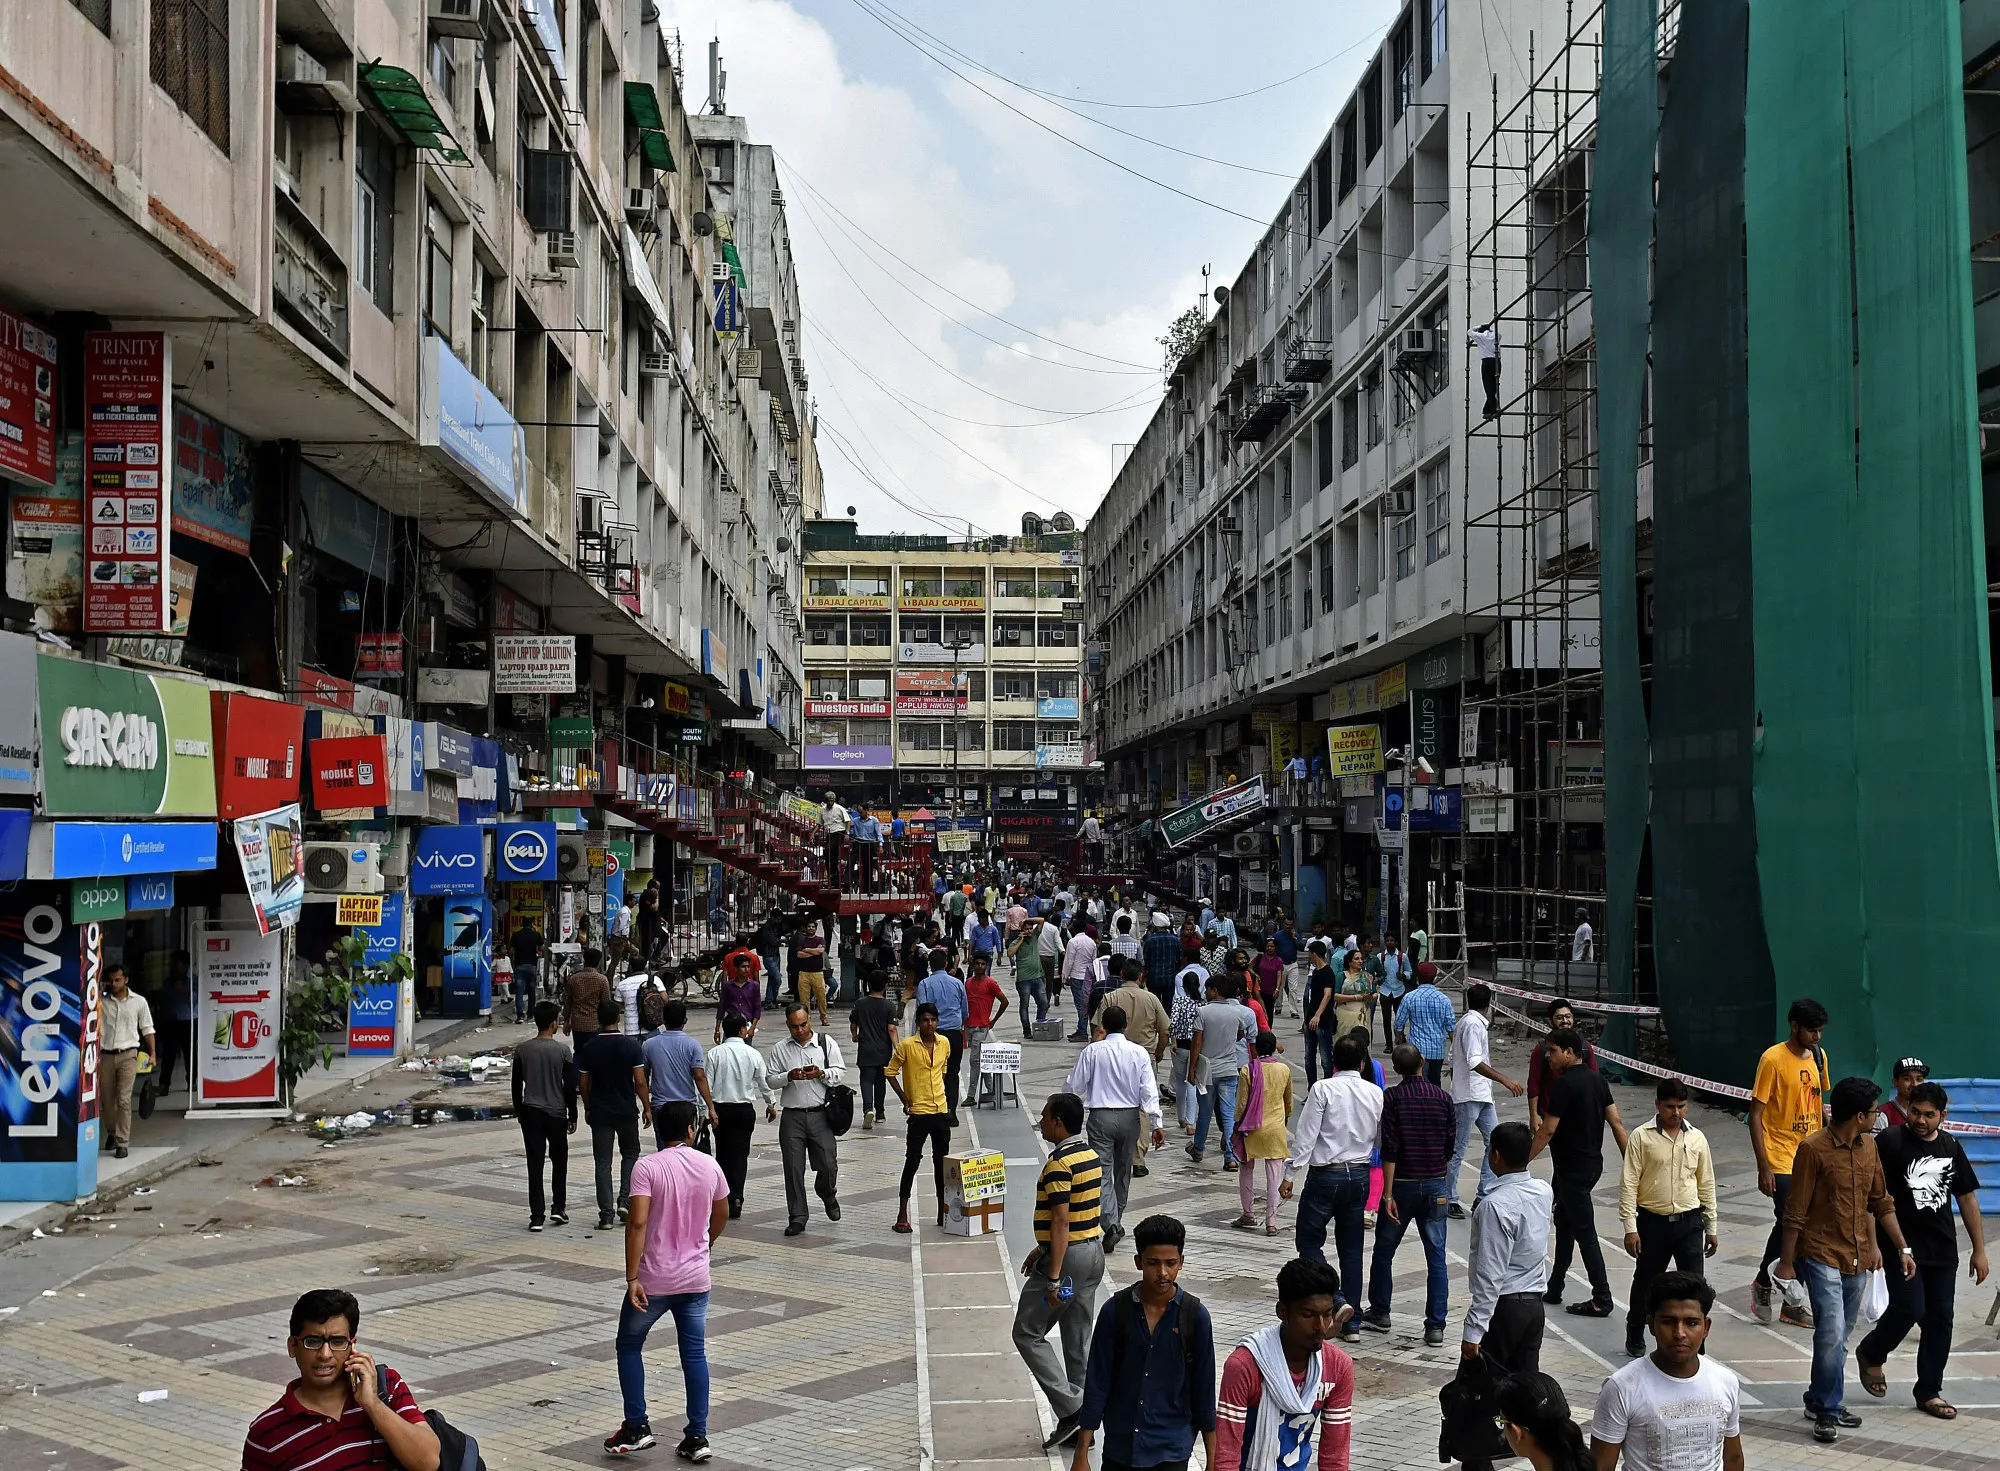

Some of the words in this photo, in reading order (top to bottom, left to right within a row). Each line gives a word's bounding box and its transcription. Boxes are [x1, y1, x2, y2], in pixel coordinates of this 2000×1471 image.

[92, 339, 158, 356] TRINITY
[848, 598, 884, 606] CAPITAL
[912, 599, 939, 607] BAJAJ
[942, 599, 978, 607] CAPITAL
[518, 646, 540, 660] LAPTOP
[542, 646, 572, 660] SOLUTION
[500, 664, 526, 672] LAPTOP
[528, 664, 548, 672] SPARE
[550, 664, 570, 672] PARTS
[811, 703, 858, 713] Investors
[860, 703, 886, 713] India
[61, 706, 158, 770] SARGAM
[1341, 730, 1366, 739] DATA
[1334, 738, 1376, 750] RECOVERY
[832, 751, 864, 760] logitech
[1338, 753, 1375, 762] LAPTOP
[246, 758, 268, 779] MOBILE
[336, 760, 354, 769] THE
[1340, 762, 1375, 771] REPAIR
[321, 769, 354, 780] MOBILE
[326, 780, 354, 788] STORE
[649, 782, 674, 804] hp
[1223, 796, 1239, 806] DELL
[1439, 795, 1448, 814] SBI
[1000, 817, 1052, 826] GIGABYTE
[507, 846, 544, 858] DELL
[416, 850, 476, 868] vivo
[140, 878, 166, 901] vivo
[512, 888, 542, 900] REPAIR
[80, 887, 120, 908] oppo
[340, 898, 379, 910] LAPTOP
[340, 911, 378, 923] RREPAIR
[352, 997, 394, 1010] vivo
[82, 922, 100, 1104] Lenovo
[8, 904, 63, 1138] Lenovo
[232, 1010, 270, 1048] 0%
[352, 1033, 390, 1042] Lenovo
[978, 1162, 1003, 1173] LAMINATION
[965, 1172, 986, 1182] TEMPERED
